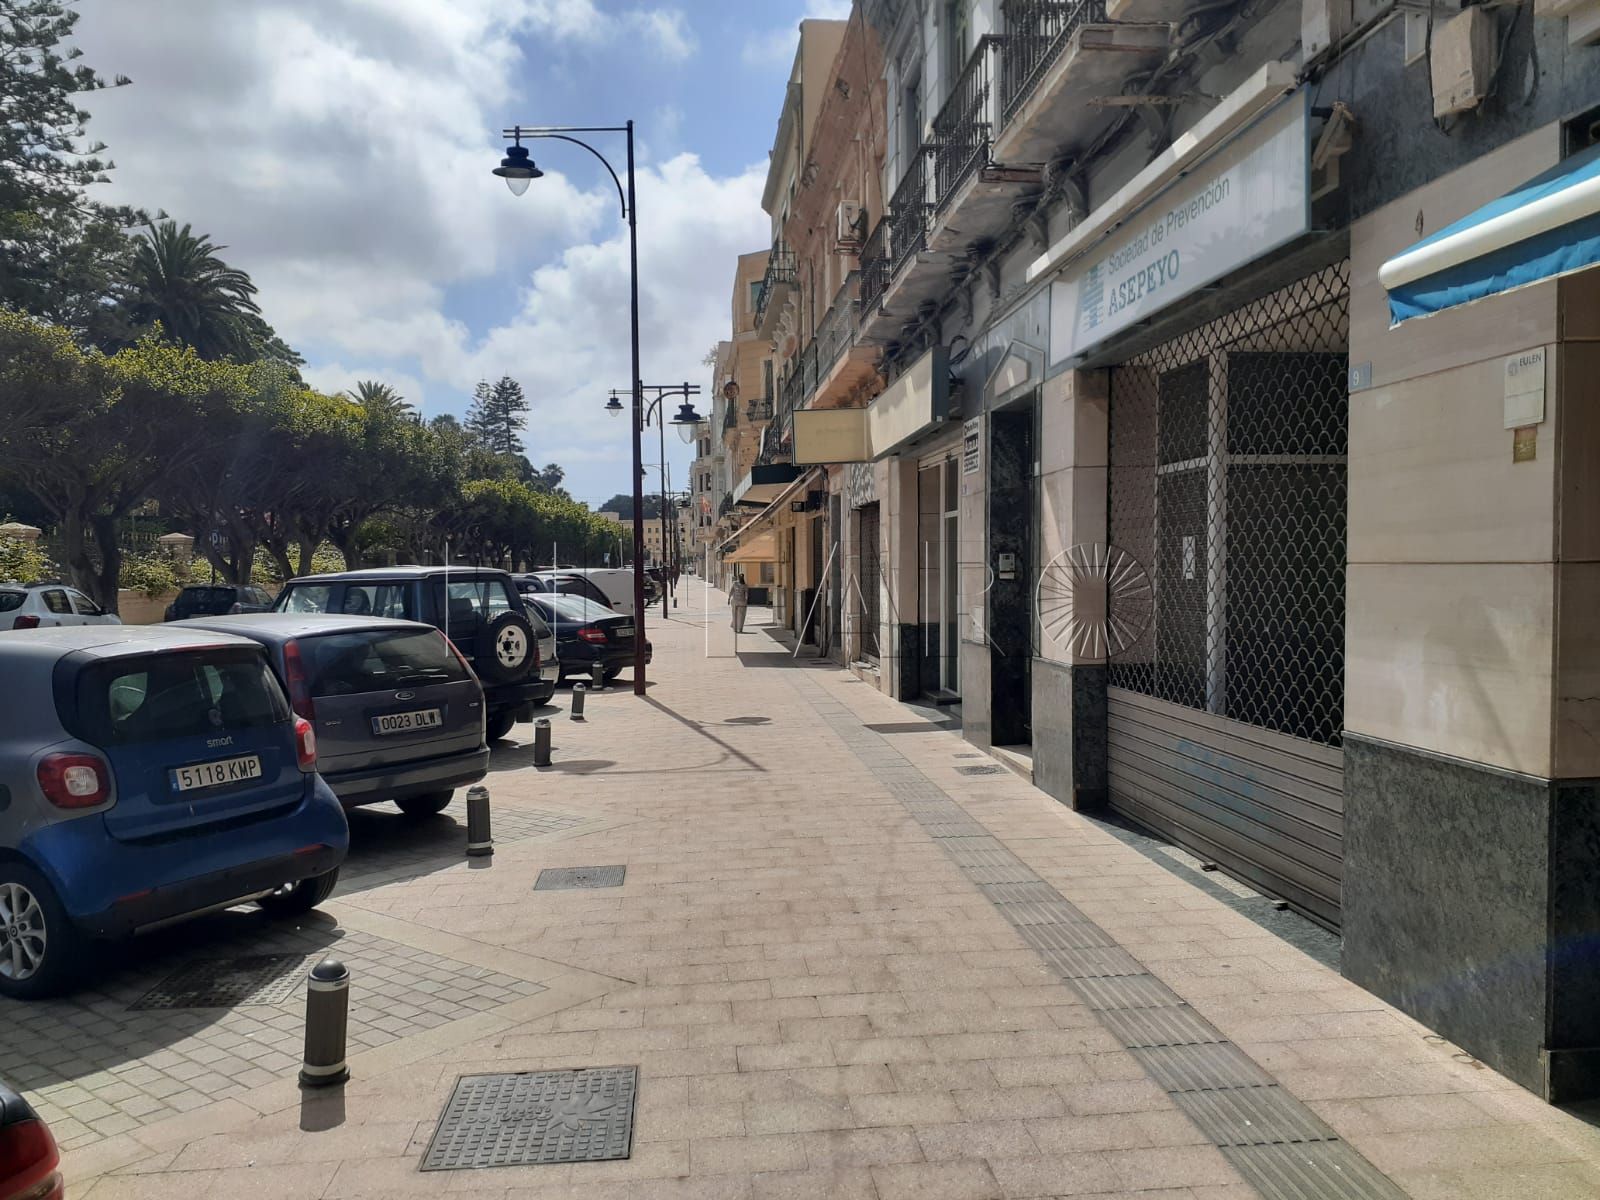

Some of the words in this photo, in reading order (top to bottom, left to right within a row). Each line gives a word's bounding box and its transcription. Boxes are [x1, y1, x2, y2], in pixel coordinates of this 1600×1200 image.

[1108, 233, 1149, 275] Sociedad
[1151, 223, 1164, 246] de
[1166, 177, 1230, 238] Prevención
[1107, 248, 1181, 317] ASEPEYO
[1519, 352, 1542, 367] EULEN
[381, 715, 412, 731] 0023
[415, 713, 436, 727] DLW
[181, 763, 225, 788] 5118
[228, 758, 257, 780] KMP
